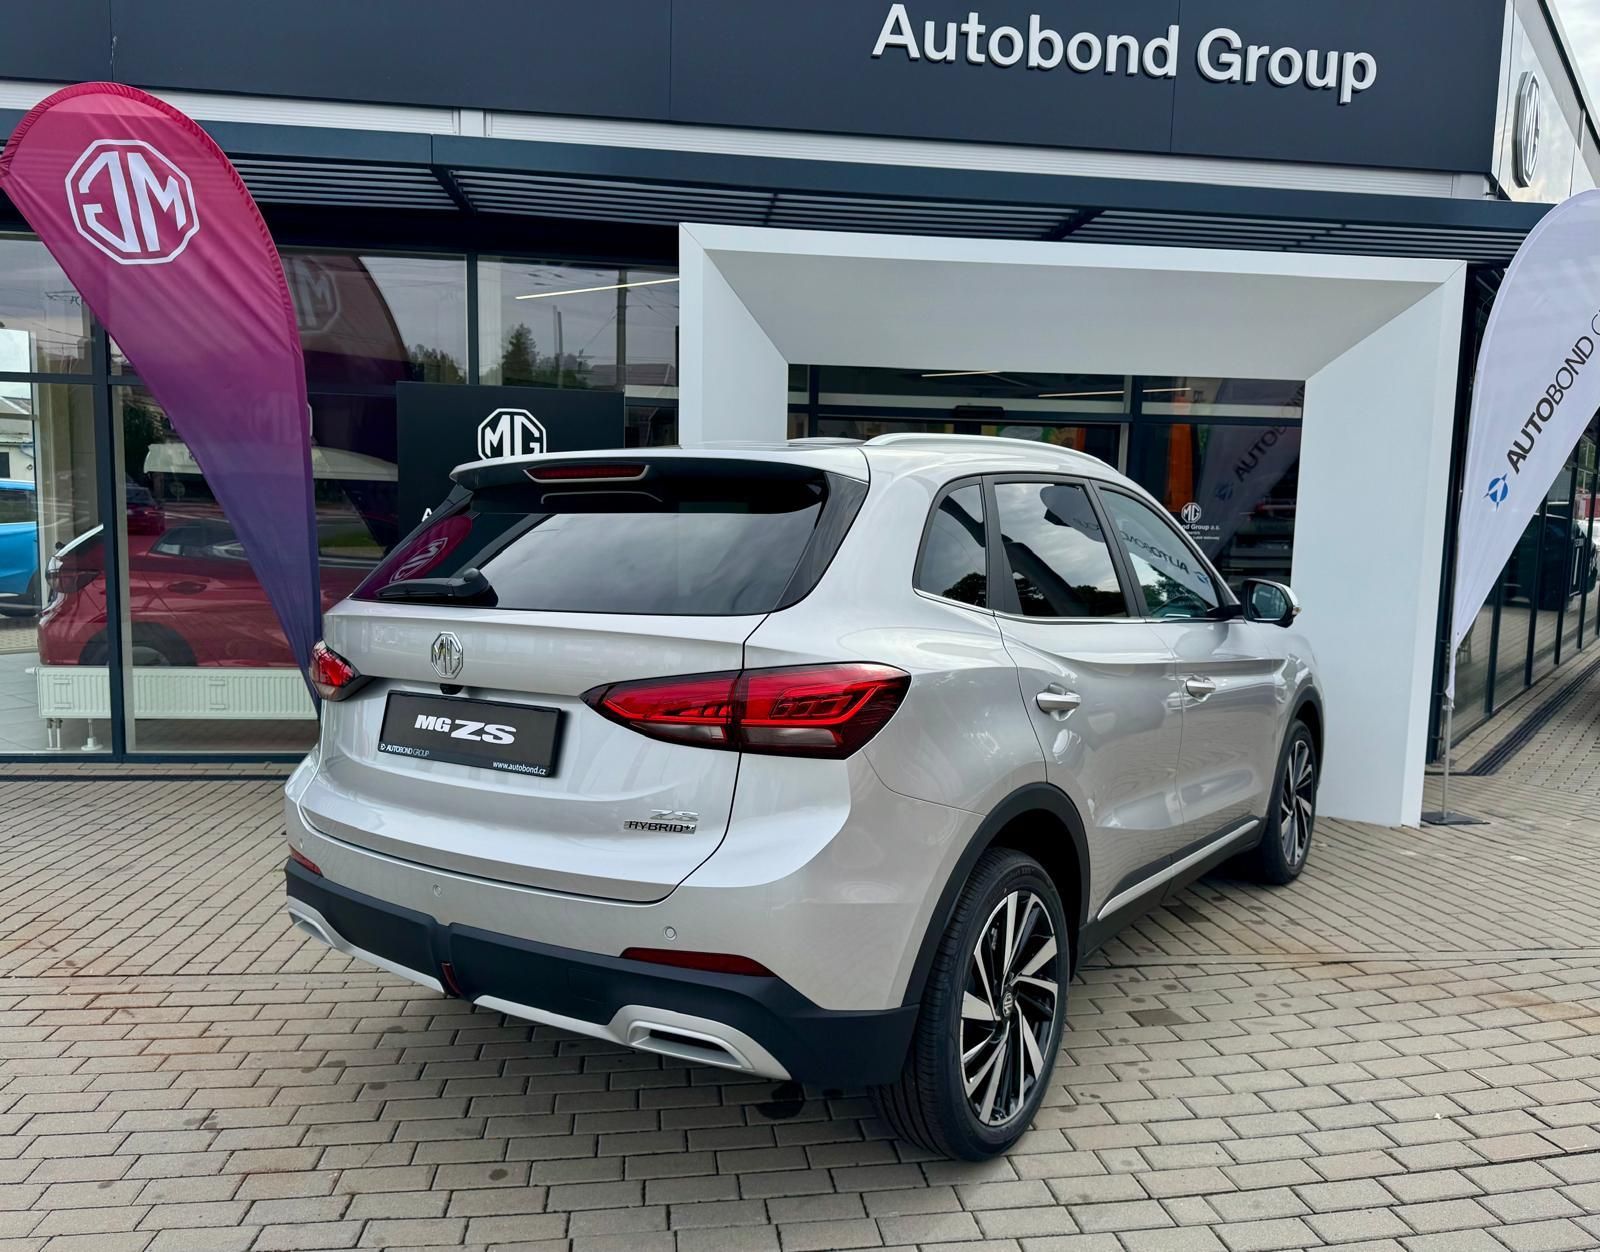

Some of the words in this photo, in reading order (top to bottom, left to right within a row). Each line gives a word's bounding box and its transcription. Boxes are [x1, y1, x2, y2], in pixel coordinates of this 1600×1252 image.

[870, 3, 1180, 79] Autobond
[1197, 27, 1378, 105] Group
[1505, 335, 1595, 475] AUTOBOND
[483, 413, 542, 458] MG
[1182, 504, 1200, 521] MG
[1190, 523, 1210, 531] Group
[432, 634, 462, 677] MG
[414, 713, 452, 734] MG
[450, 719, 517, 745] ZS
[385, 743, 413, 755] AUTOBOND
[412, 748, 430, 757] GROUP
[492, 761, 547, 775] www.autobond.cz
[649, 809, 699, 822] ZS
